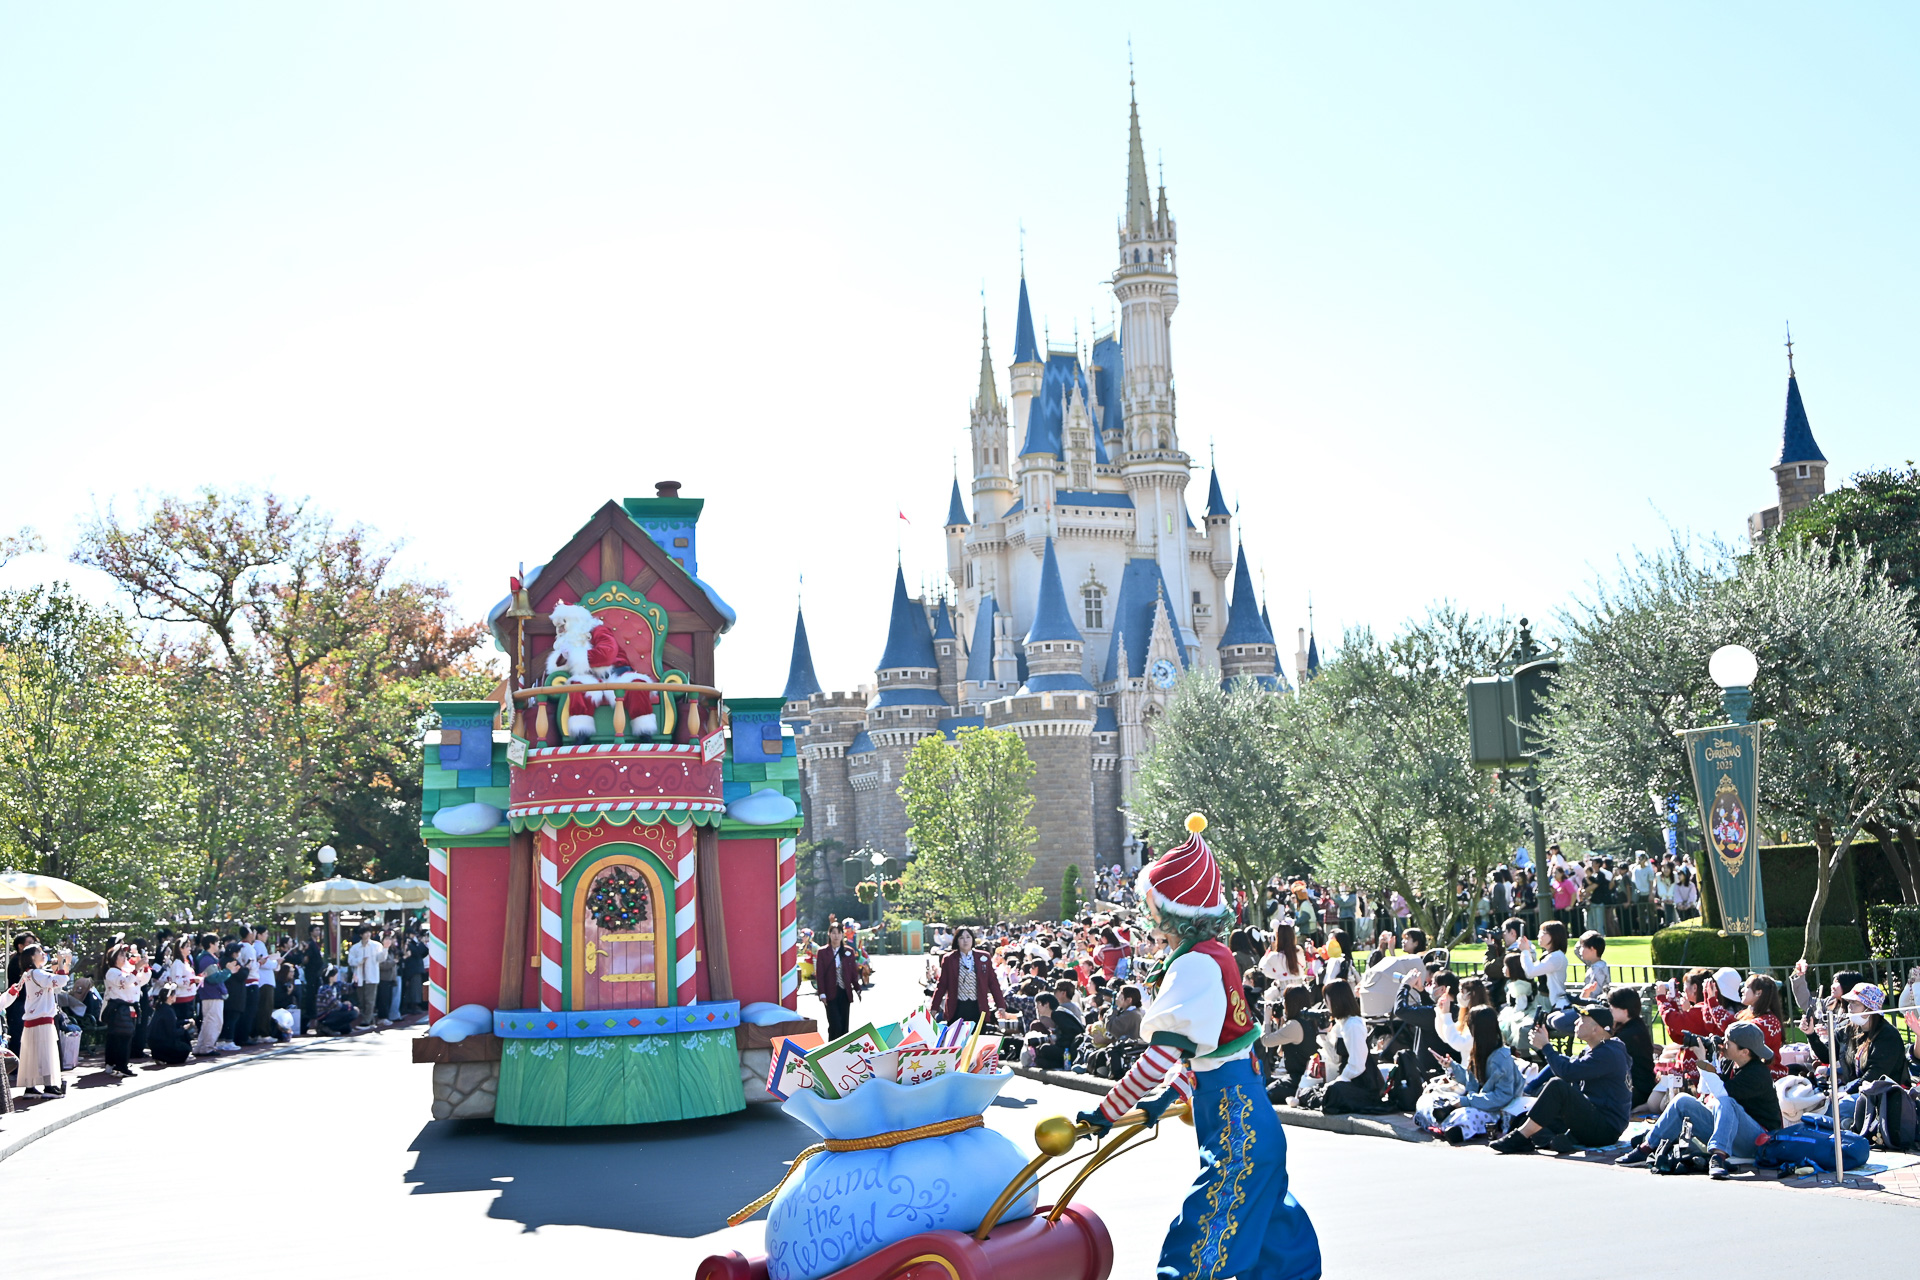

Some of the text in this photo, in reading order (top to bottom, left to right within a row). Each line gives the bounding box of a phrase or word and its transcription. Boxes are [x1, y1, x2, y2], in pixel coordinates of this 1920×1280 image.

[1716, 761, 1733, 770] 2025
[803, 1205, 843, 1237] the
[793, 1201, 883, 1276] World
